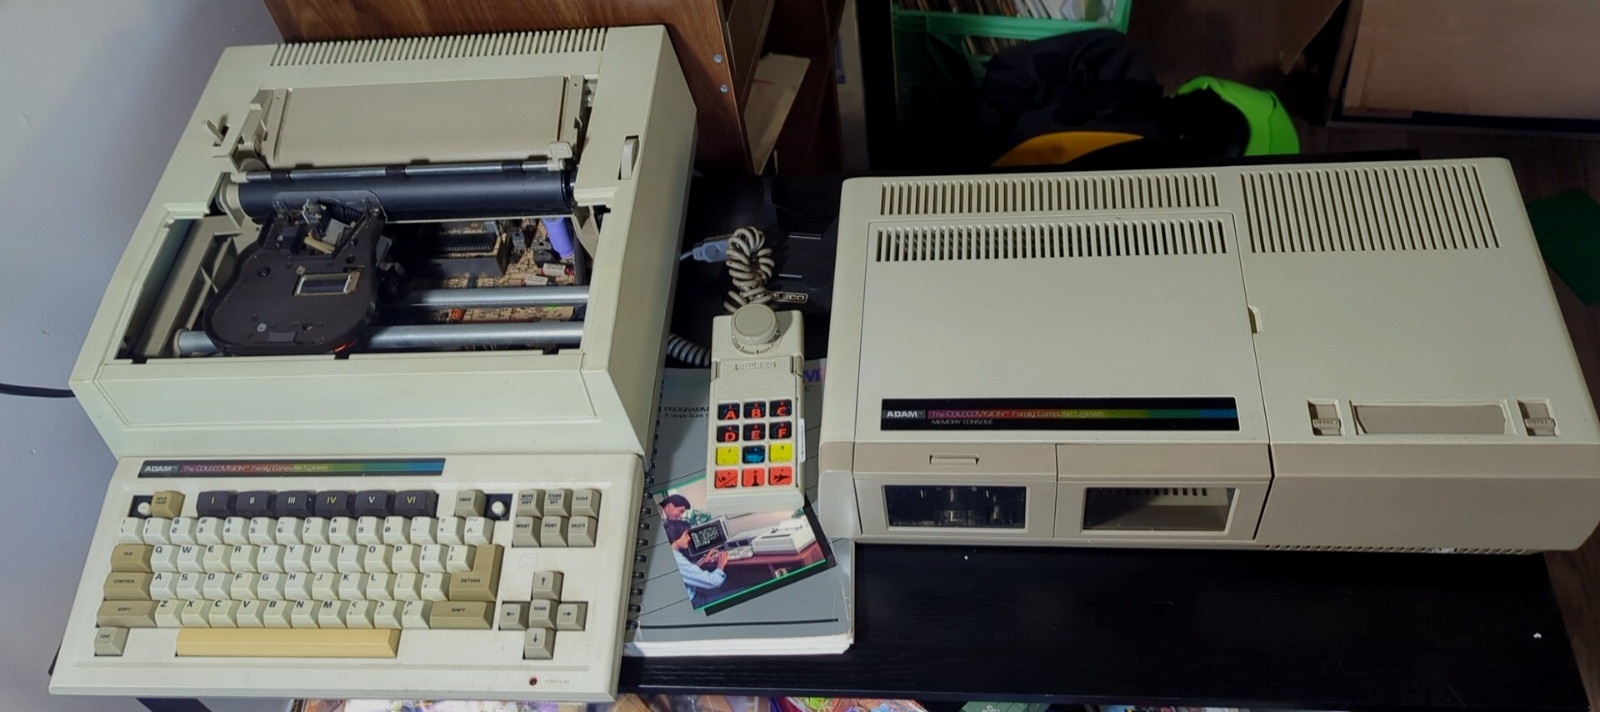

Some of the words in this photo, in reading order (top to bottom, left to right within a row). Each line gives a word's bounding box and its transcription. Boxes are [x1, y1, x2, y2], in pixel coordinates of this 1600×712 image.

[725, 410, 737, 420] A
[751, 408, 761, 419] B
[776, 406, 787, 416] C
[886, 410, 918, 418] ADAM
[932, 410, 945, 418] The
[725, 431, 736, 442] D
[751, 430, 761, 440] E
[778, 428, 788, 438] F
[249, 496, 255, 504] II
[181, 573, 188, 581] S
[262, 573, 269, 581] G
[243, 600, 251, 608] V
